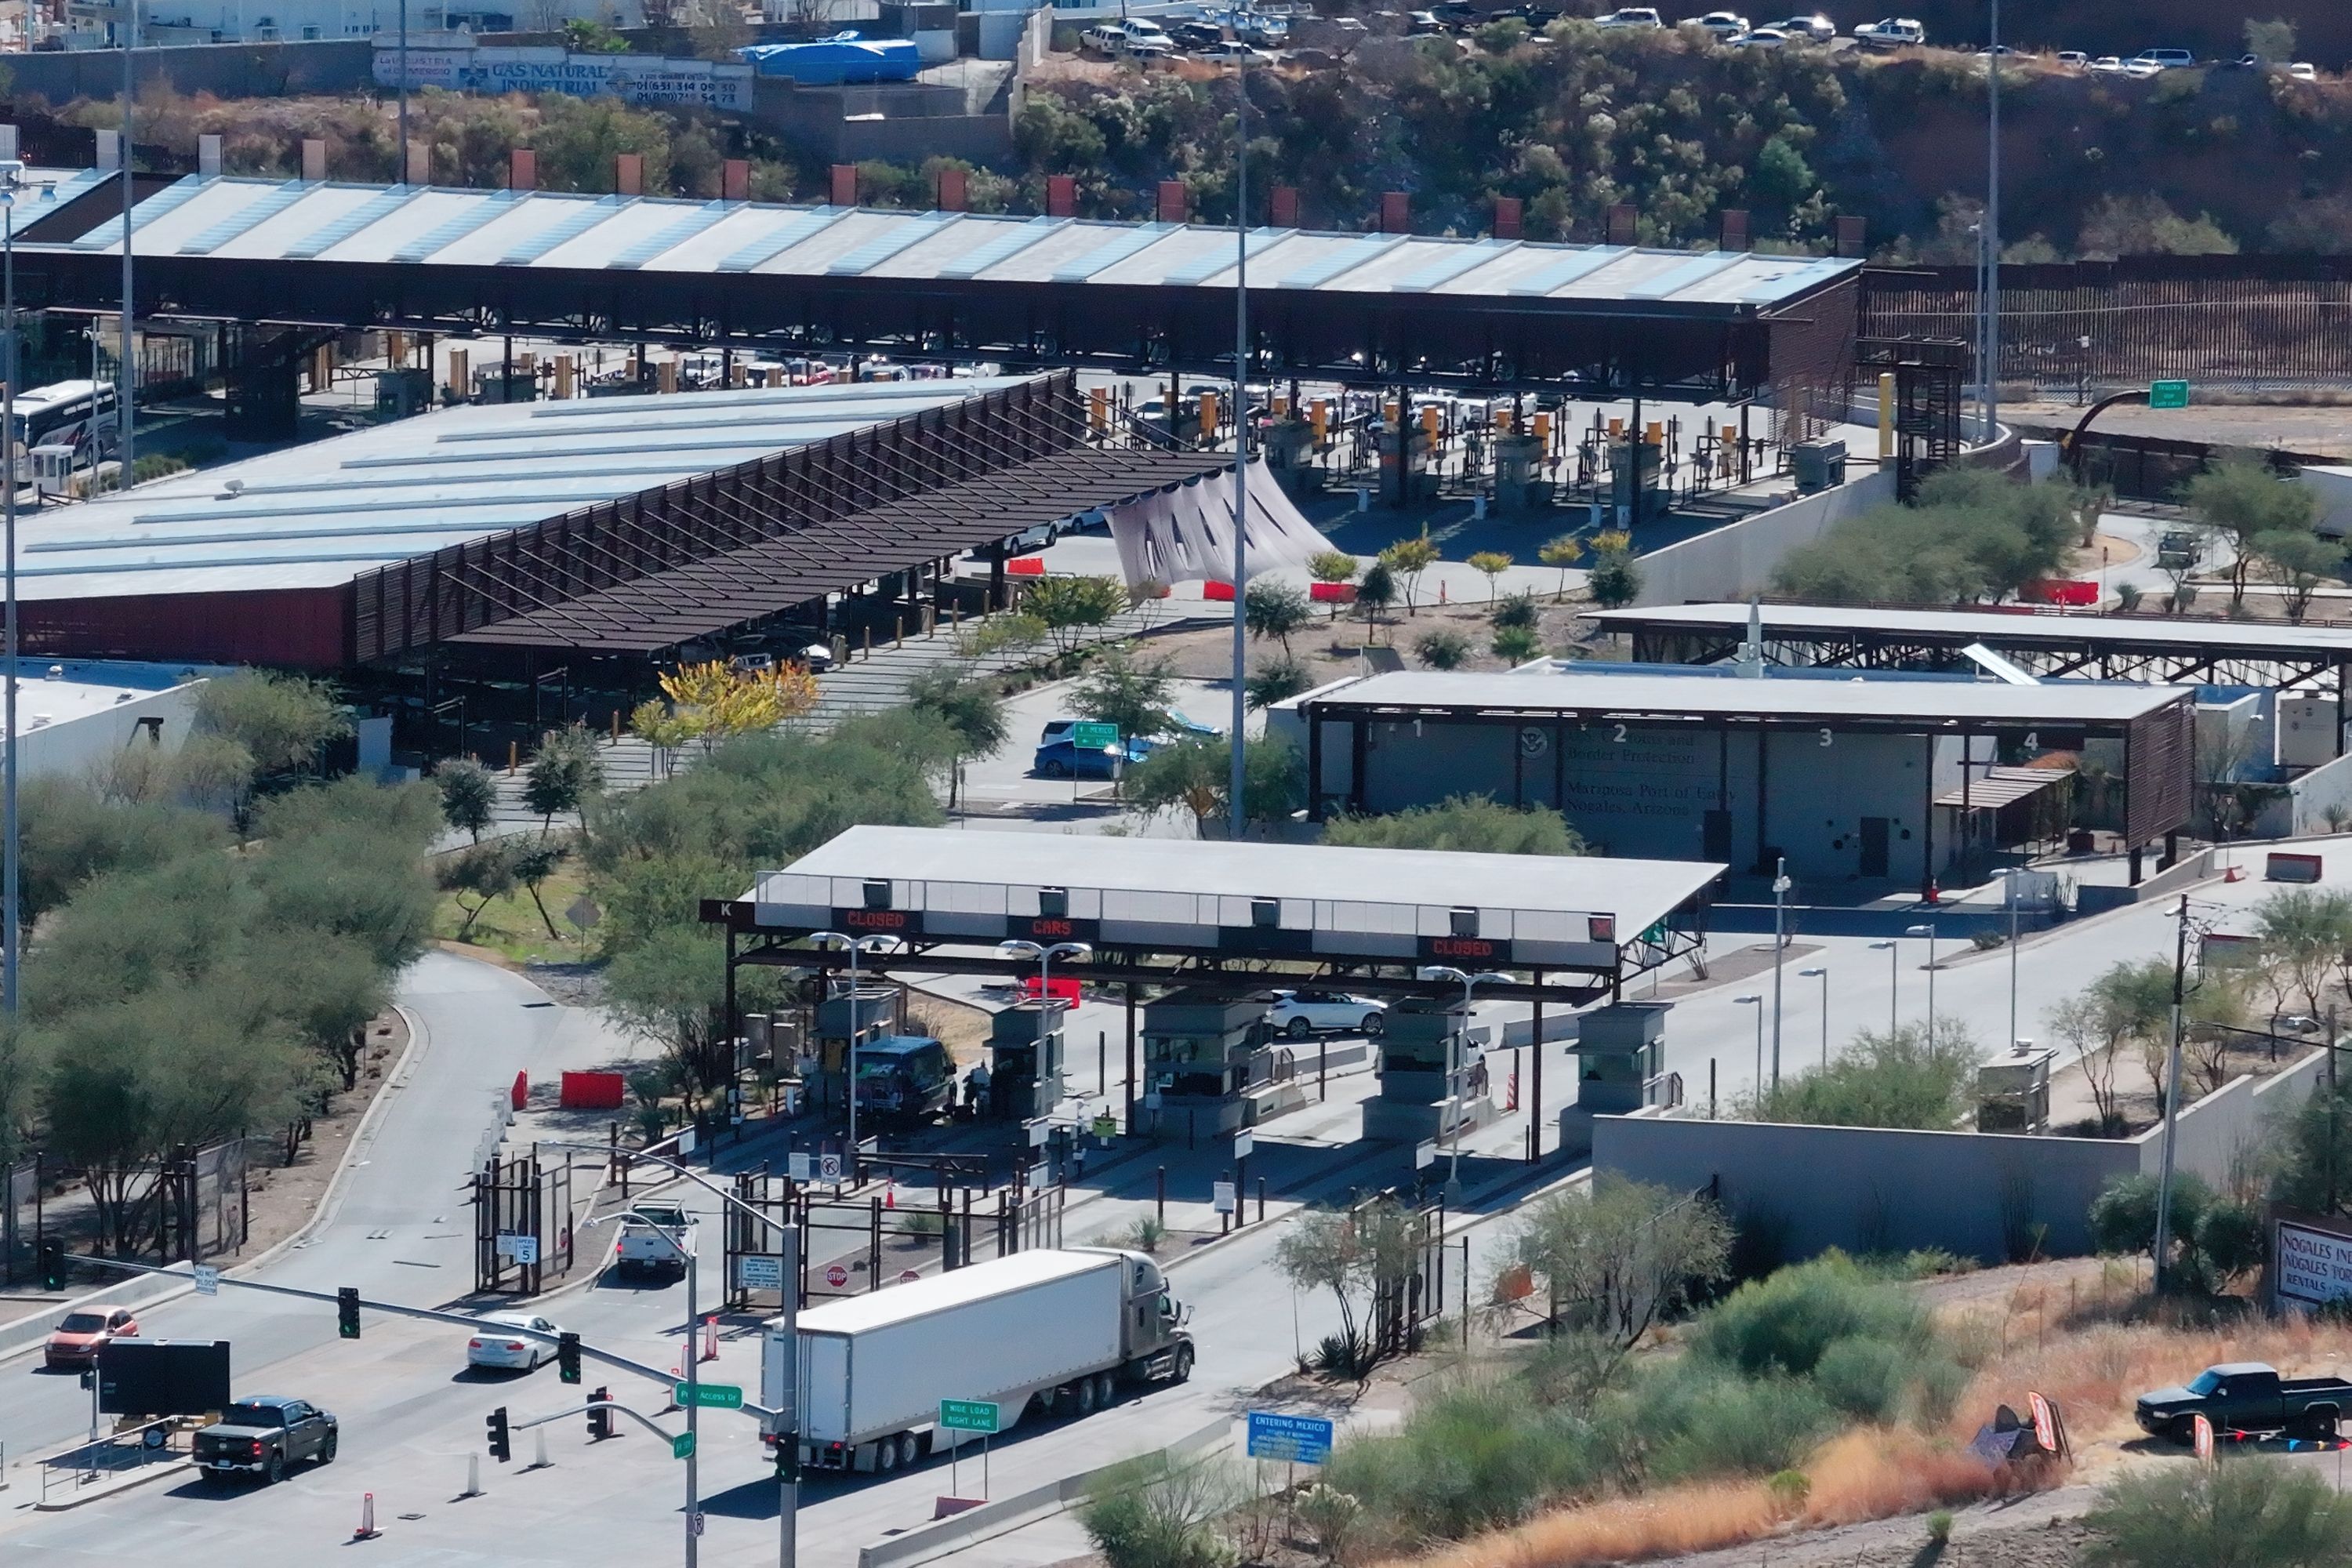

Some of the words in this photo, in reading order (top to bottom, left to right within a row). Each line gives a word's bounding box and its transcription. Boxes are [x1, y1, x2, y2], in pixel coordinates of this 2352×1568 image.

[492, 64, 527, 77] GAS
[532, 64, 608, 78] NATURAL
[1733, 304, 1741, 314] A
[1413, 719, 1421, 737] 1
[1613, 724, 1627, 742] 2
[1820, 728, 1832, 746] 3
[2024, 732, 2038, 751] 4
[1568, 747, 1615, 761] Border
[1639, 783, 1669, 797] Port
[1675, 786, 1689, 798] of
[721, 902, 731, 916] K
[848, 910, 904, 927] CLOSED
[1033, 920, 1071, 935] CARS
[1434, 940, 1493, 956] CLOSED
[522, 1250, 530, 1260] 5
[2281, 1235, 2332, 1260] NOGALES
[2283, 1253, 2328, 1277] NOGALES
[828, 1272, 847, 1281] STOP
[2286, 1272, 2326, 1294] RENTALS
[699, 1392, 725, 1401] Access
[728, 1394, 737, 1403] Dr
[949, 1404, 967, 1414] WIDE
[970, 1406, 989, 1416] LOAD
[948, 1416, 969, 1425] RIGHT
[973, 1418, 991, 1428] LANE
[1256, 1417, 1294, 1428] ENTERING
[1296, 1421, 1326, 1432] MEXICO
